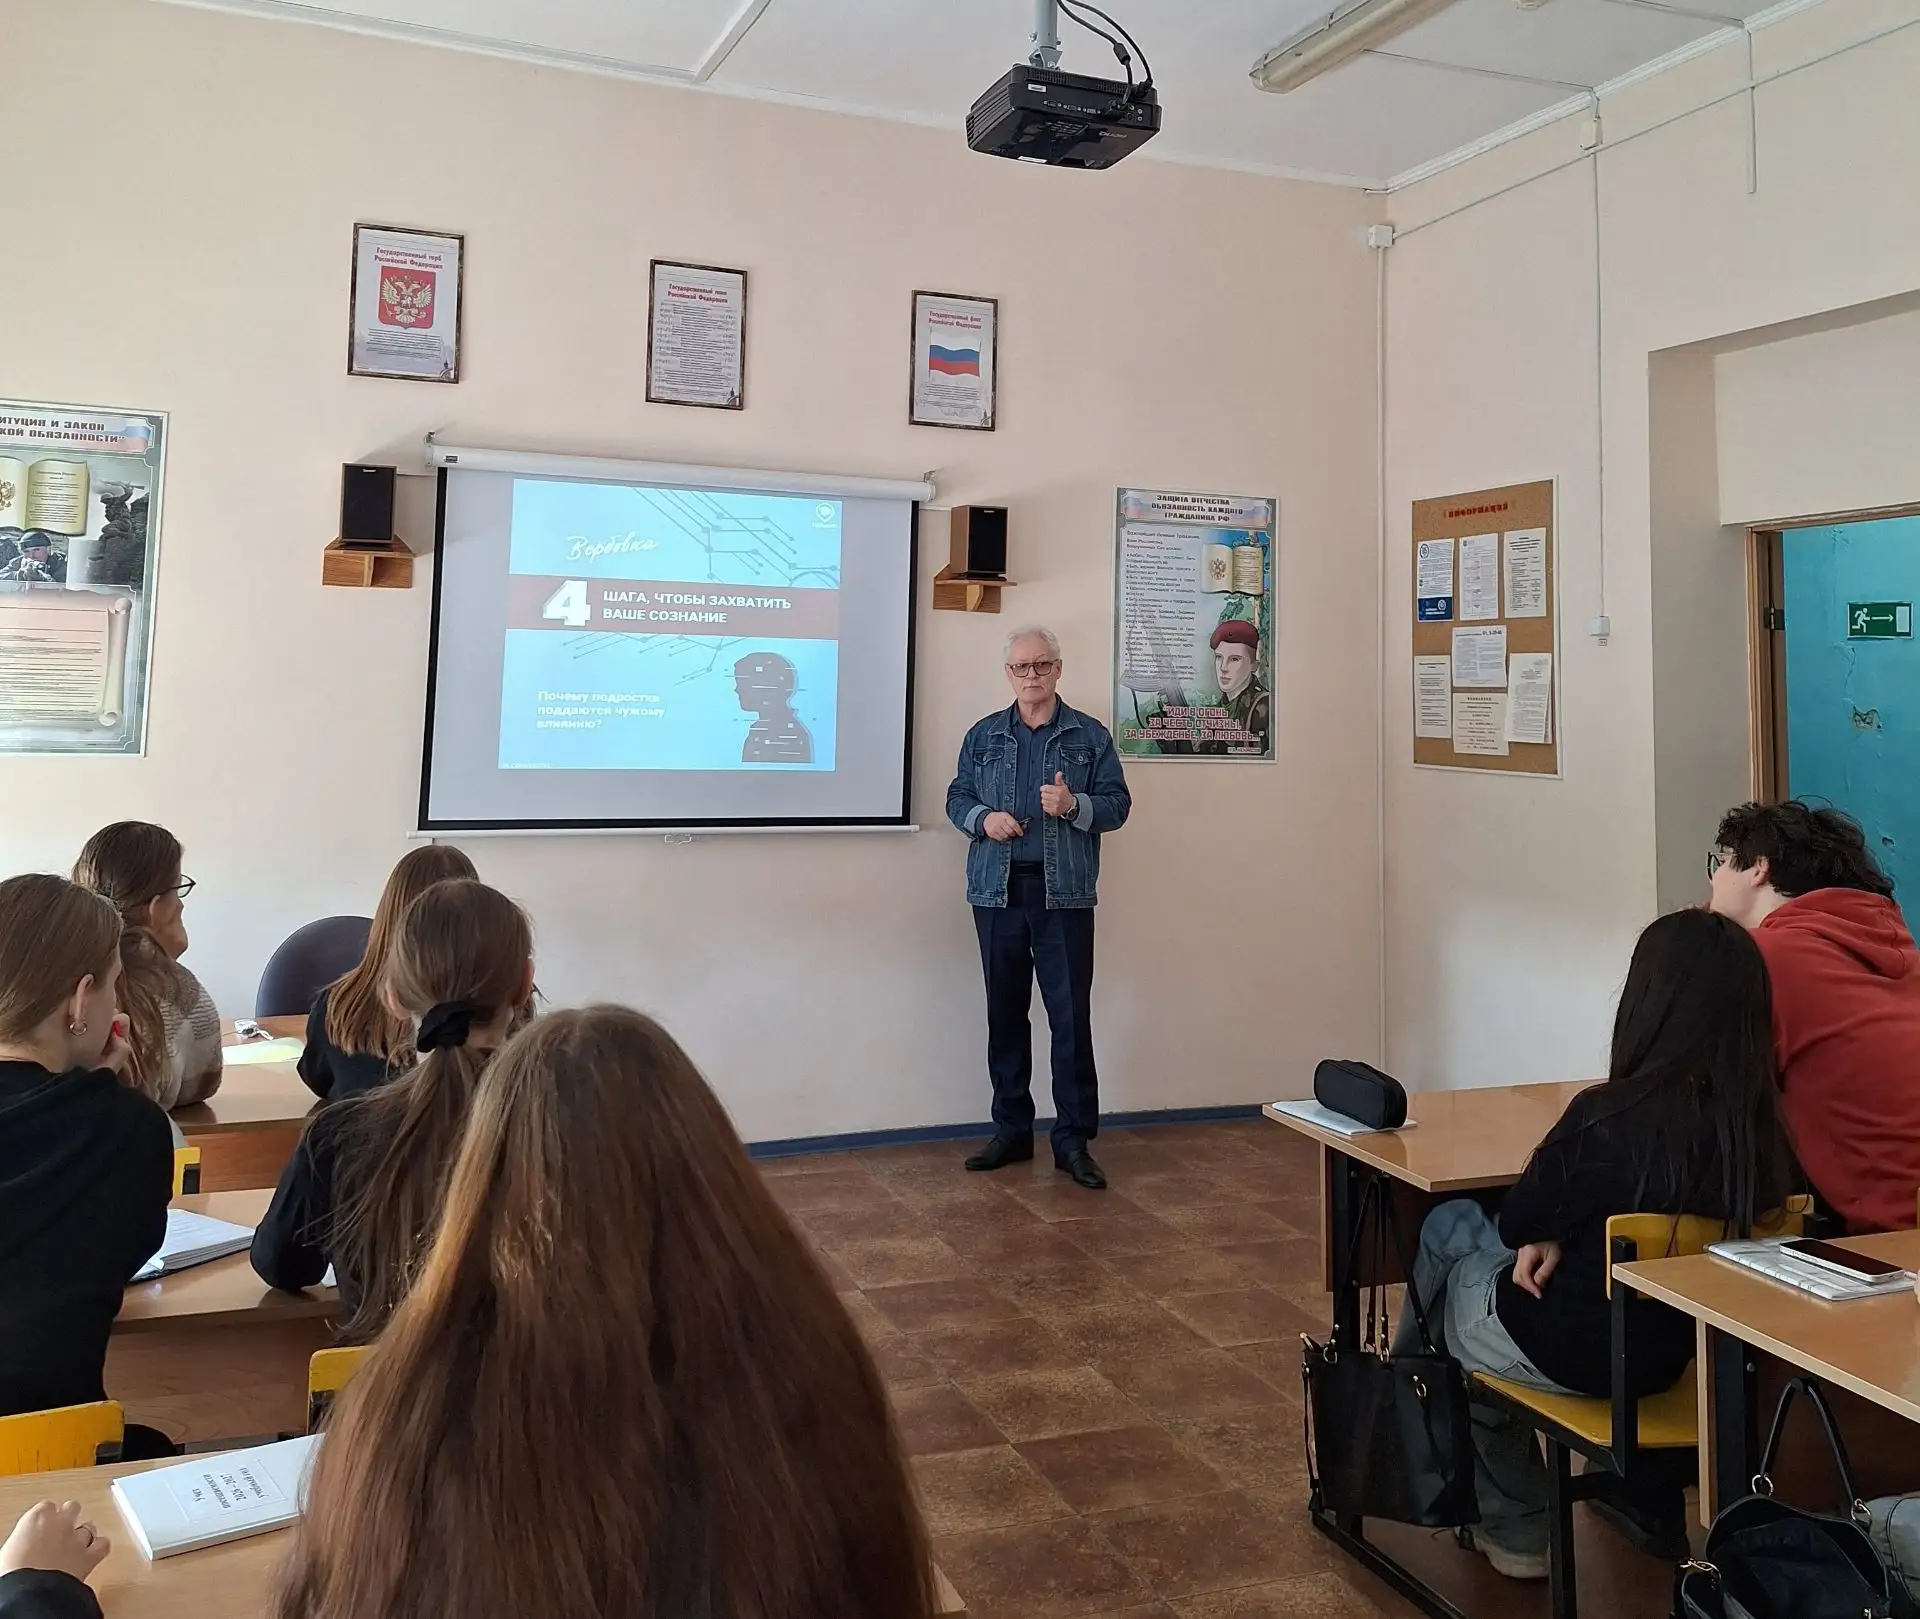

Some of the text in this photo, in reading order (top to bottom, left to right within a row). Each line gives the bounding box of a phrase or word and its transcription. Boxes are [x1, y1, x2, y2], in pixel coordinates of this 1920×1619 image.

[376, 247, 427, 259] Государственный
[374, 254, 443, 270] Российской Федерации
[669, 283, 714, 294] Государственный
[668, 290, 728, 303] Российской Федерации
[51, 420, 59, 428] И
[64, 421, 105, 431] ЗАКОН
[1157, 495, 1189, 503] ЗАЩИТА
[1191, 496, 1230, 506] ОТЕЧЕСТВА
[1151, 503, 1244, 515] ОБЯЗАННОСТЬ КАЖДОГО
[1448, 501, 1509, 518] ИНФОРМАЦИЯ
[1164, 512, 1216, 521] ГРАЖДАНИНА
[566, 531, 660, 563] Вербовка
[542, 579, 592, 626] 4
[603, 591, 792, 610] ШАГА, ЧТОБЫ ЗАХВАТИТЬ
[603, 608, 728, 624] ВАШЕ СОЗНАНИЕ
[537, 691, 661, 704] Почему подростки
[537, 706, 665, 719] поддаются чужому
[1189, 707, 1197, 717] В
[1198, 707, 1229, 718] ОГОНЬ
[536, 719, 602, 729] влиянию?
[1149, 718, 1242, 730] ЗА ЧЕСТЬ ОТЧИЗНЫ,
[1125, 730, 1137, 739] ЗА
[1201, 730, 1213, 740] ЗА
